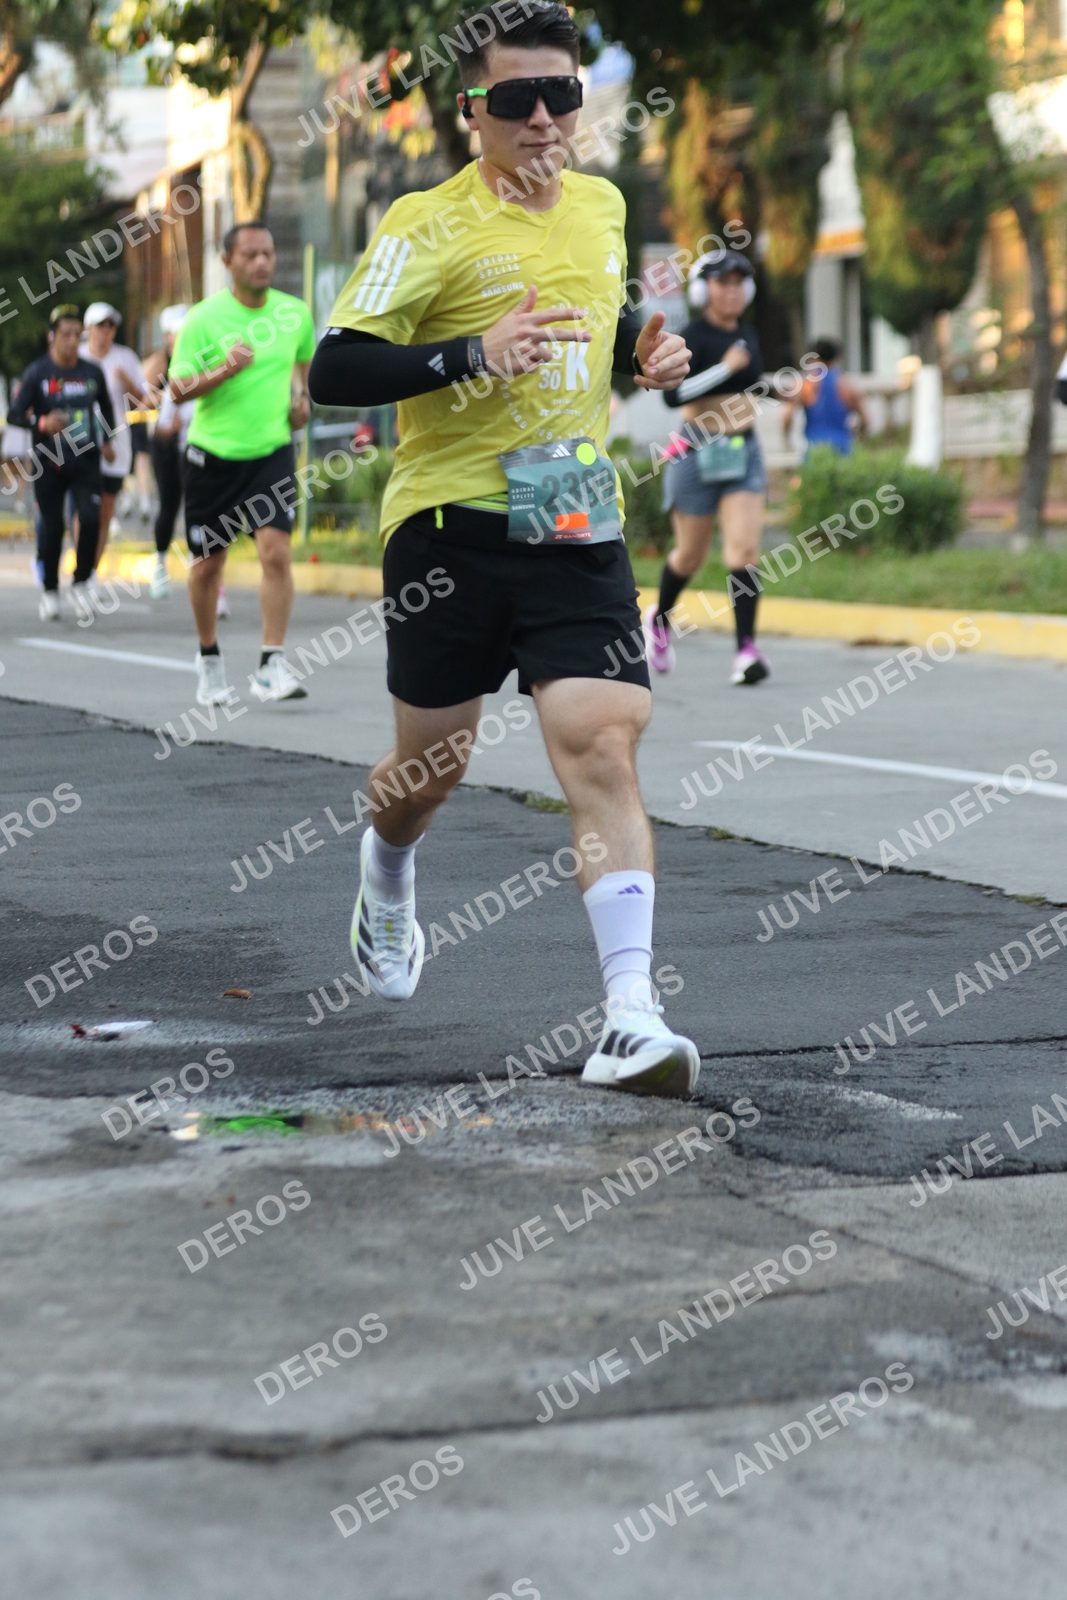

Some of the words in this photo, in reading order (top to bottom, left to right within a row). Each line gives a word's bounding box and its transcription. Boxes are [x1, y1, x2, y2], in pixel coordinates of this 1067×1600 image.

[480, 282, 524, 298] SAMSUNG
[566, 341, 590, 391] K
[538, 368, 561, 390] 30
